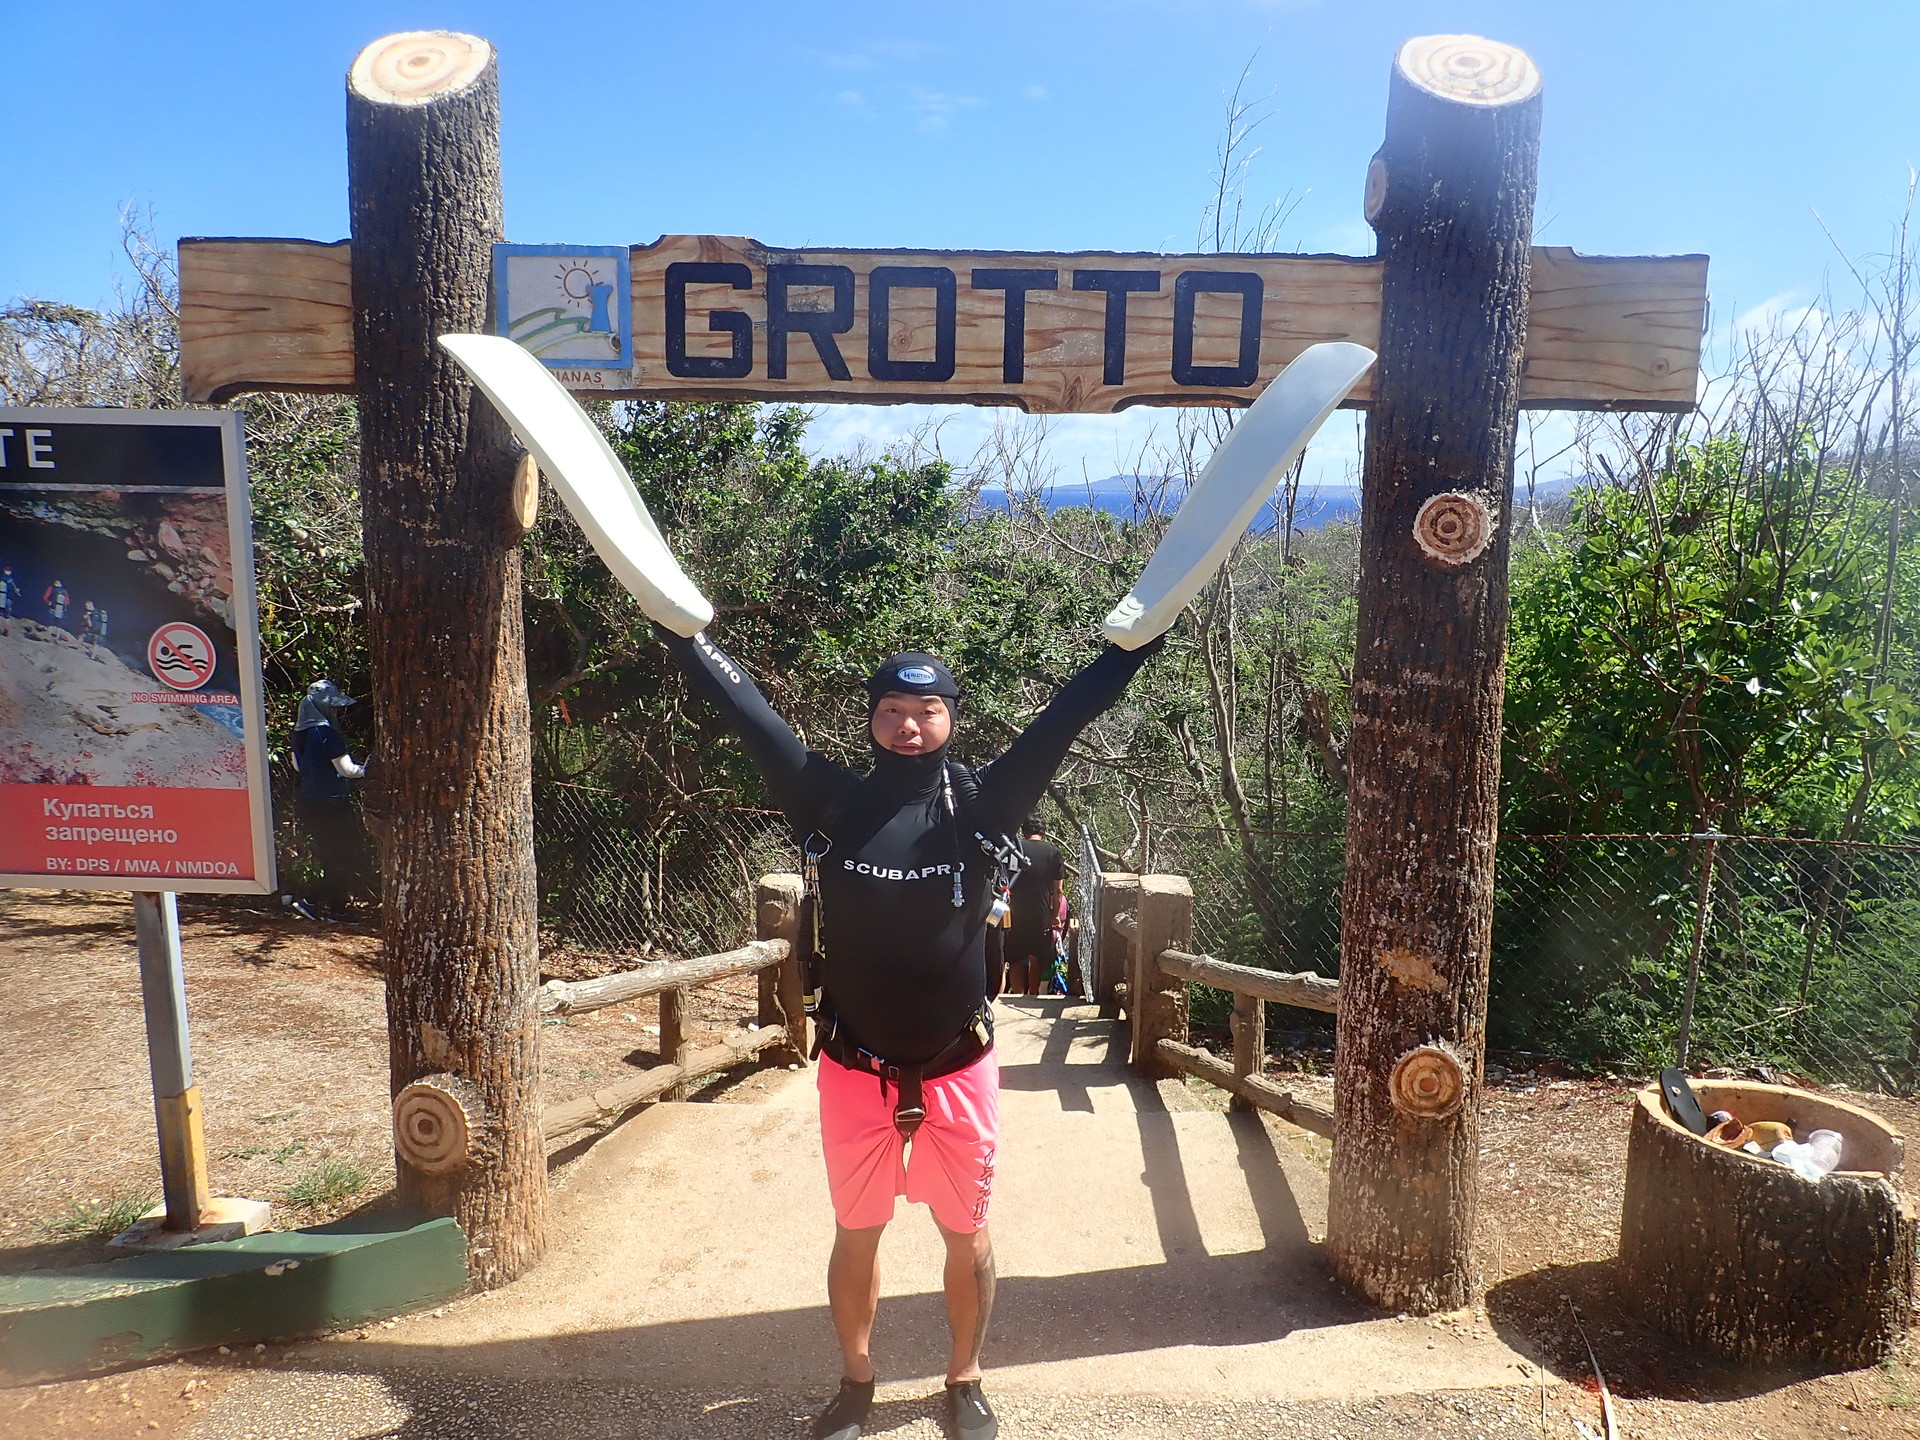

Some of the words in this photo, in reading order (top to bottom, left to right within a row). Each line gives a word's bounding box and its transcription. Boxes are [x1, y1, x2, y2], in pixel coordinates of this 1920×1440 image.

[665, 262, 1264, 387] GROTTO
[132, 693, 149, 702] NO
[151, 693, 207, 704] SWIMMING
[210, 695, 239, 704] AREA
[43, 798, 154, 821] Купаться
[45, 826, 178, 846] запрещено
[46, 857, 72, 871] BY:
[75, 858, 110, 872] DPS
[114, 859, 121, 873] /
[124, 859, 161, 873] MVA
[164, 860, 171, 873] /
[175, 861, 239, 875] NMDOA
